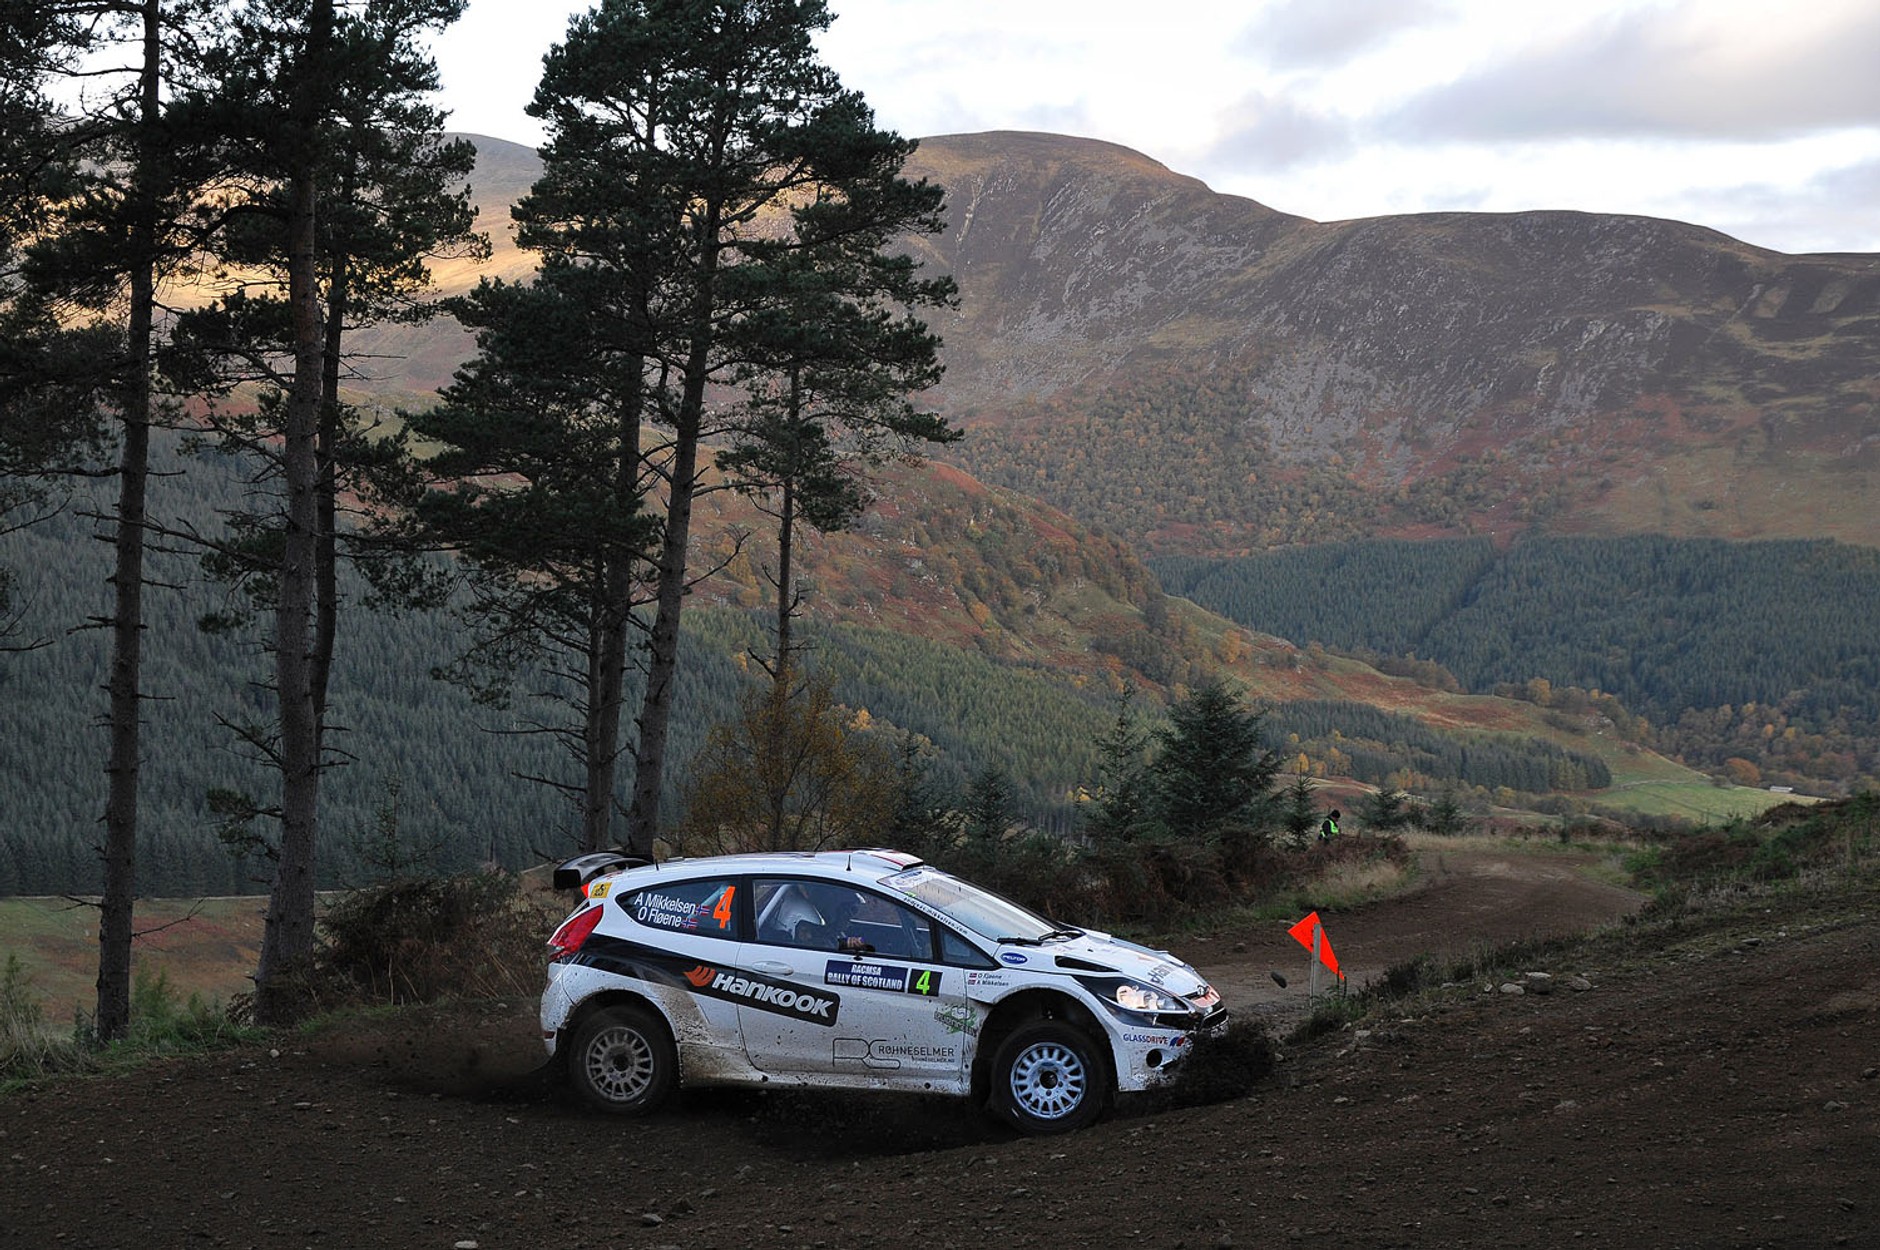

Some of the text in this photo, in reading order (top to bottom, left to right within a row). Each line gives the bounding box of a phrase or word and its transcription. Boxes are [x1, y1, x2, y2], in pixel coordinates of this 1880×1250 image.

[635, 892, 696, 914] A Mikkelsen
[714, 886, 735, 928] 4
[638, 907, 681, 926] O Fløene
[827, 972, 903, 991] RALLY OF SCOTLAND
[916, 970, 930, 995] 4
[1123, 1034, 1168, 1044] GLASSDRIVE
